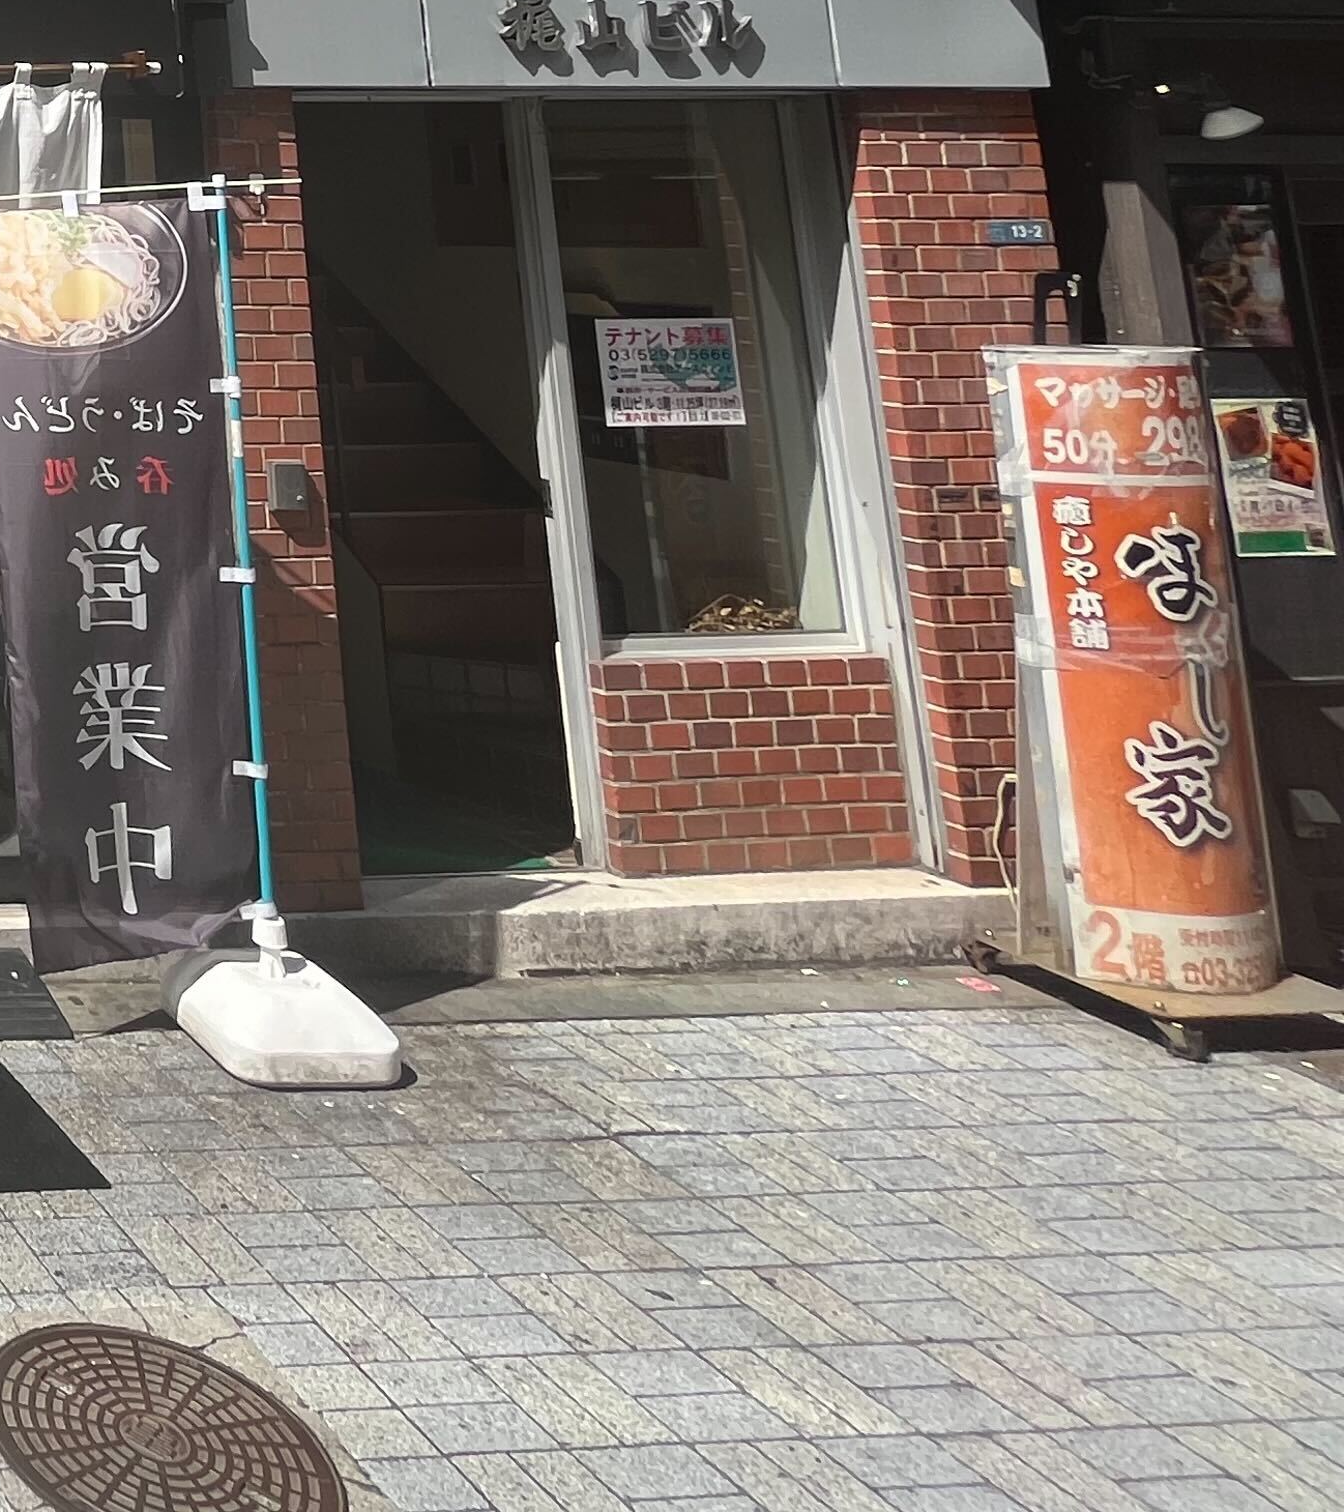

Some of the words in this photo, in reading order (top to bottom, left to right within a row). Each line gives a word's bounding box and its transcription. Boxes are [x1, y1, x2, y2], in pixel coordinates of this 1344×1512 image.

[1010, 224, 1044, 239] 13-2
[605, 326, 728, 346] テナント募集
